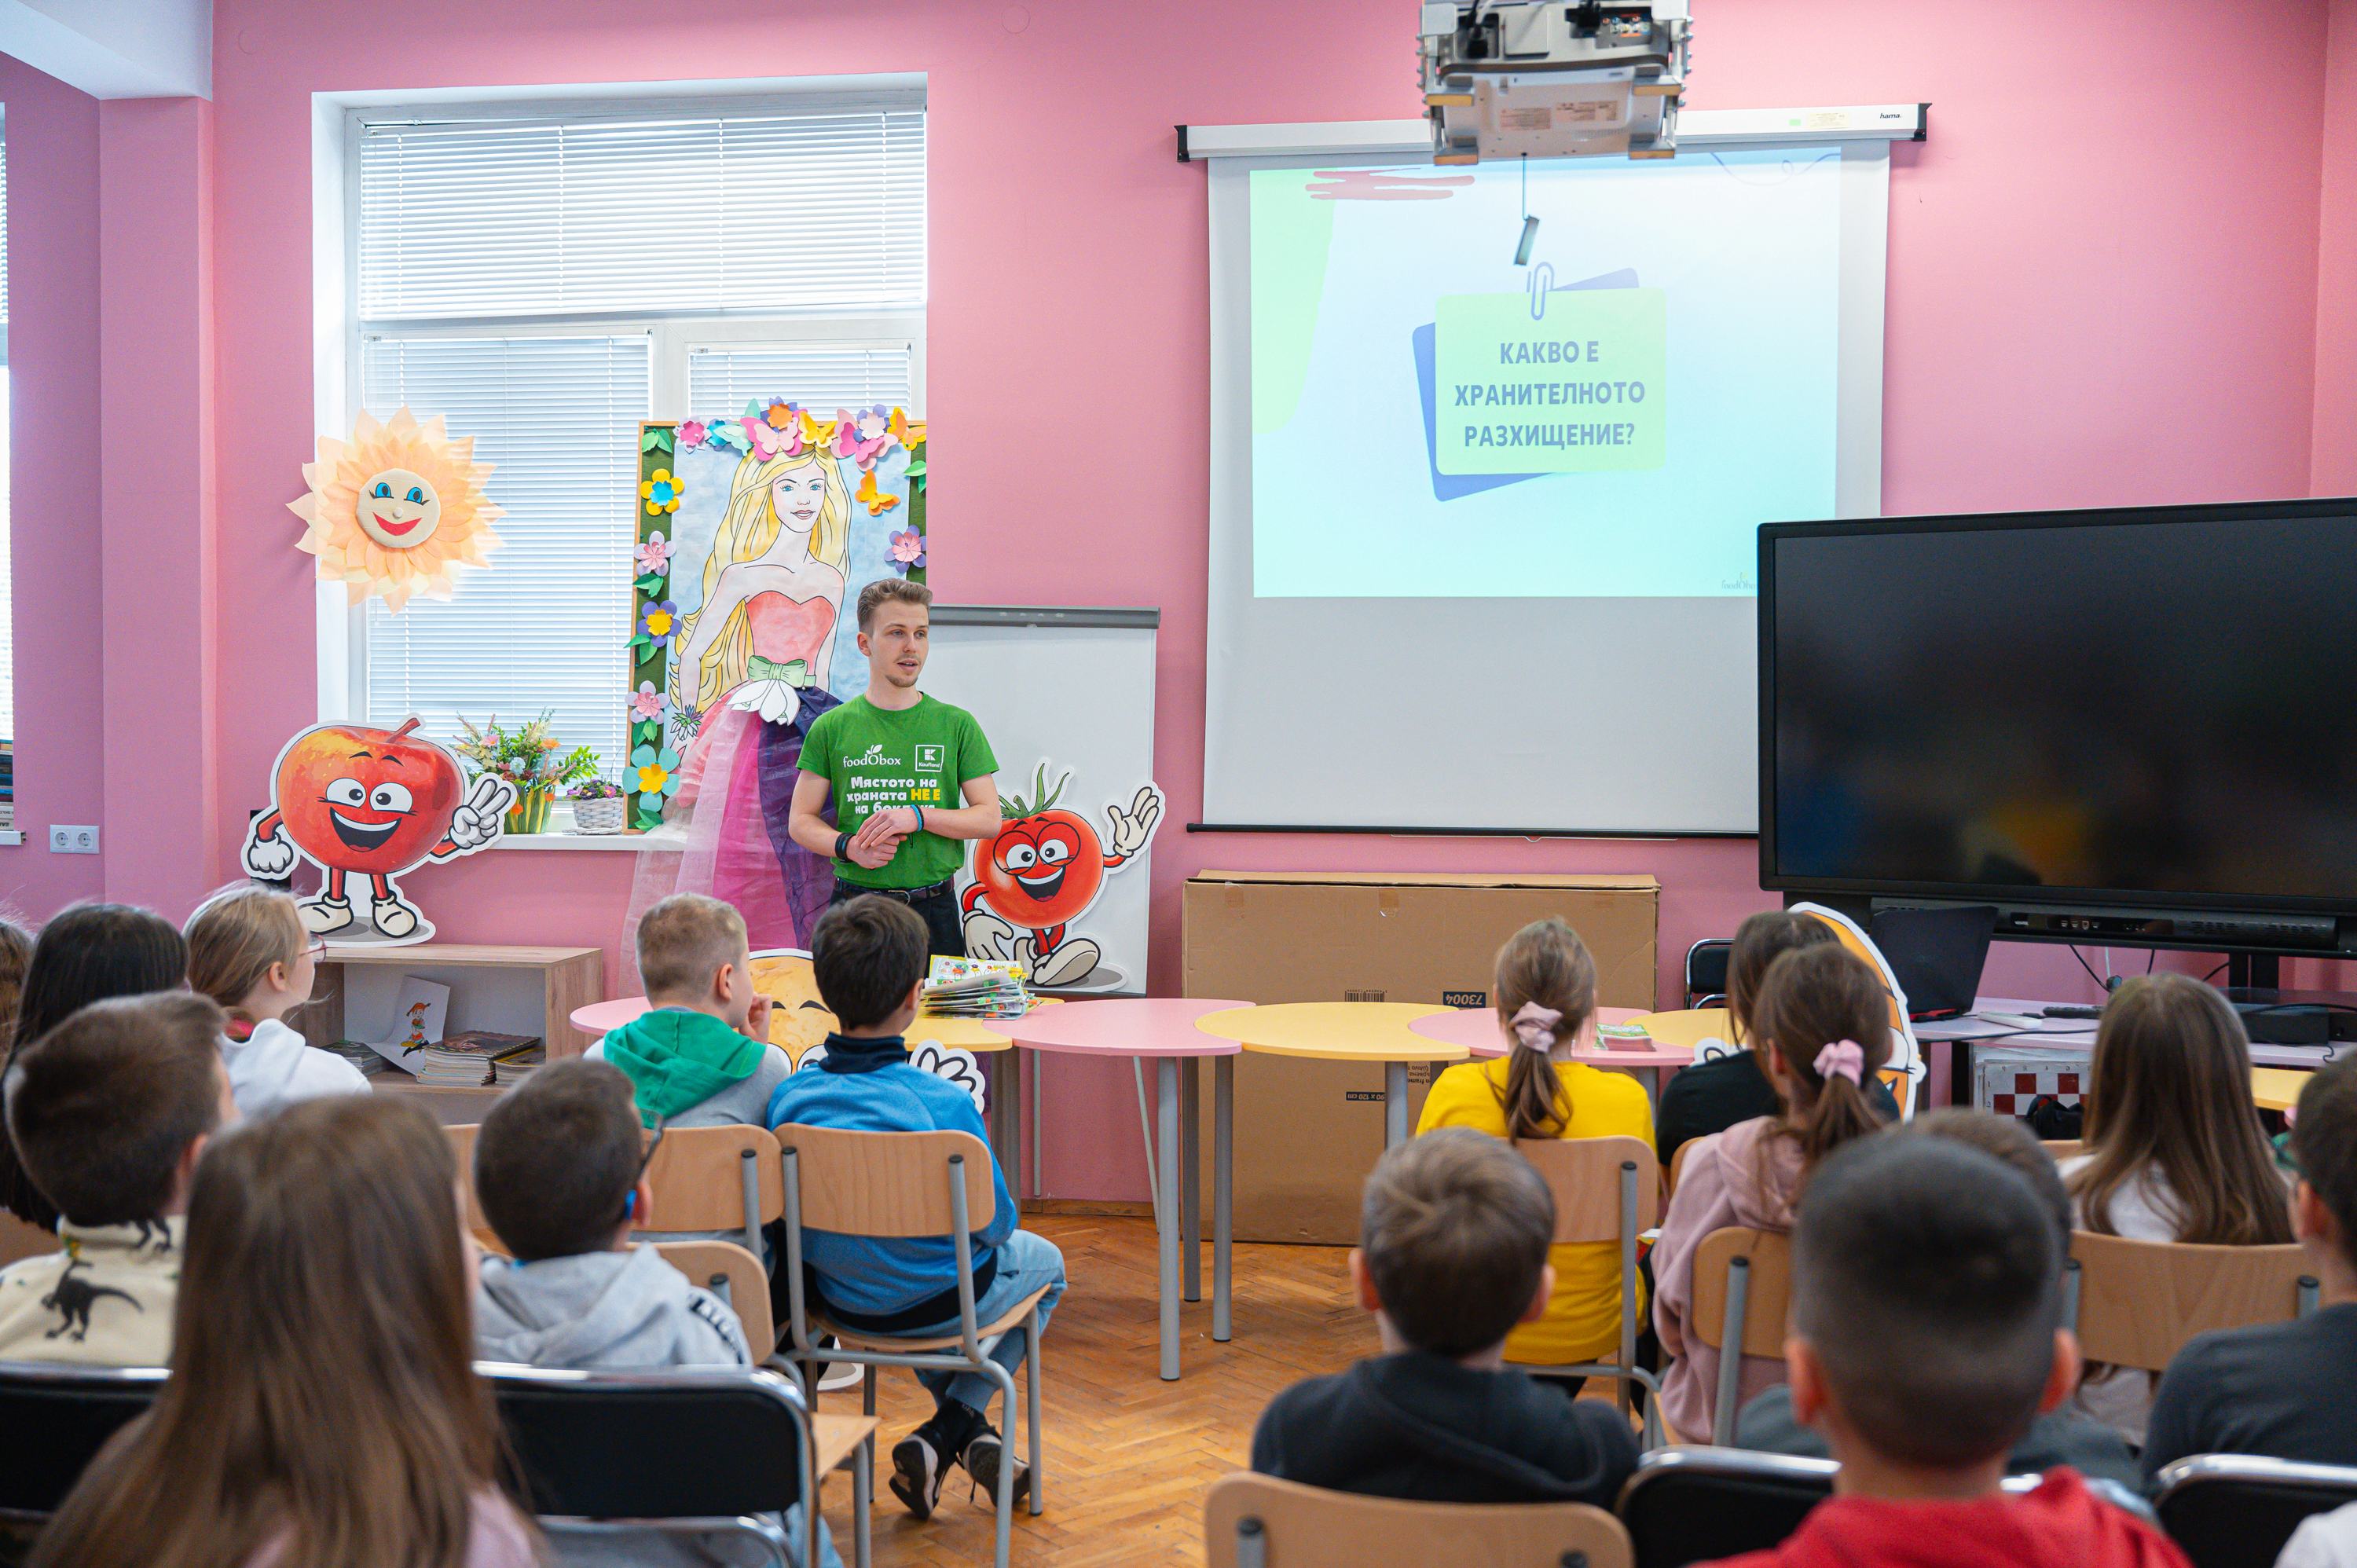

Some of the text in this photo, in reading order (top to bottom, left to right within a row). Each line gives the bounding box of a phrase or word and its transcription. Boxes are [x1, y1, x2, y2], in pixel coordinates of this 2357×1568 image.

[1499, 340, 1600, 365] КАКВО Е
[1453, 381, 1645, 406] ХРАНИТЕЛНОТО
[1464, 423, 1636, 450] РАЗХИЩЕНИЕ?
[851, 776, 937, 789] Мястото на
[846, 788, 940, 804] храната НЕ Е
[855, 804, 869, 815] на
[1445, 993, 1483, 1006] 73004
